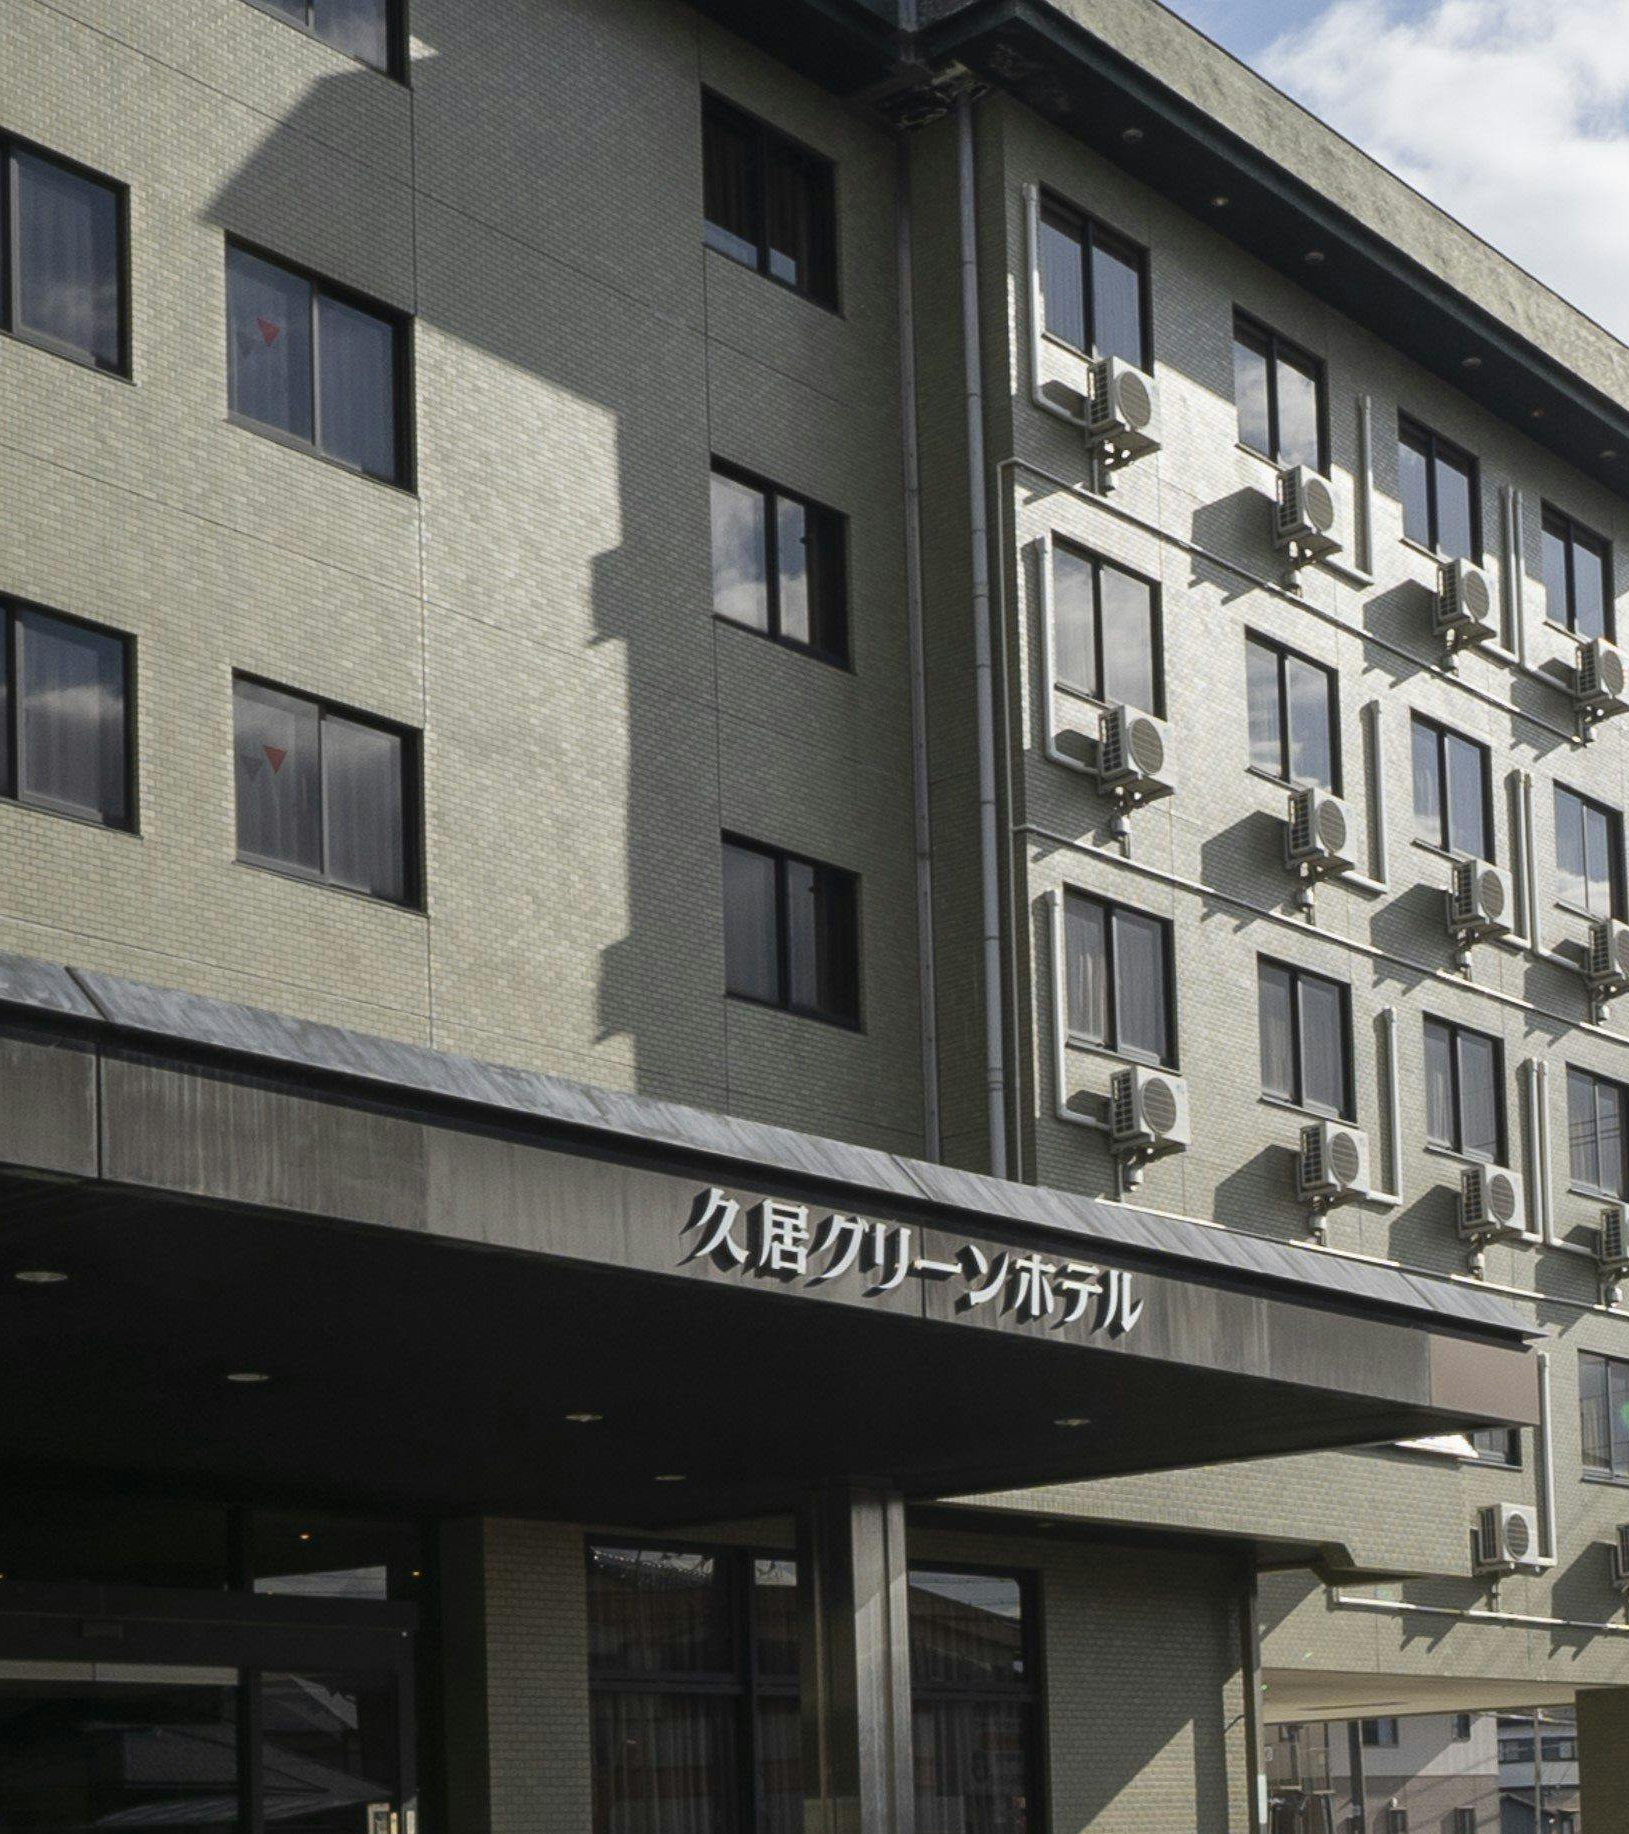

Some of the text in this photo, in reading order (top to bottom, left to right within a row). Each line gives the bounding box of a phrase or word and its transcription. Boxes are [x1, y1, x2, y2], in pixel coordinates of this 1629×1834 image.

[695, 1187, 1144, 1333] 久居グリーンホテル
